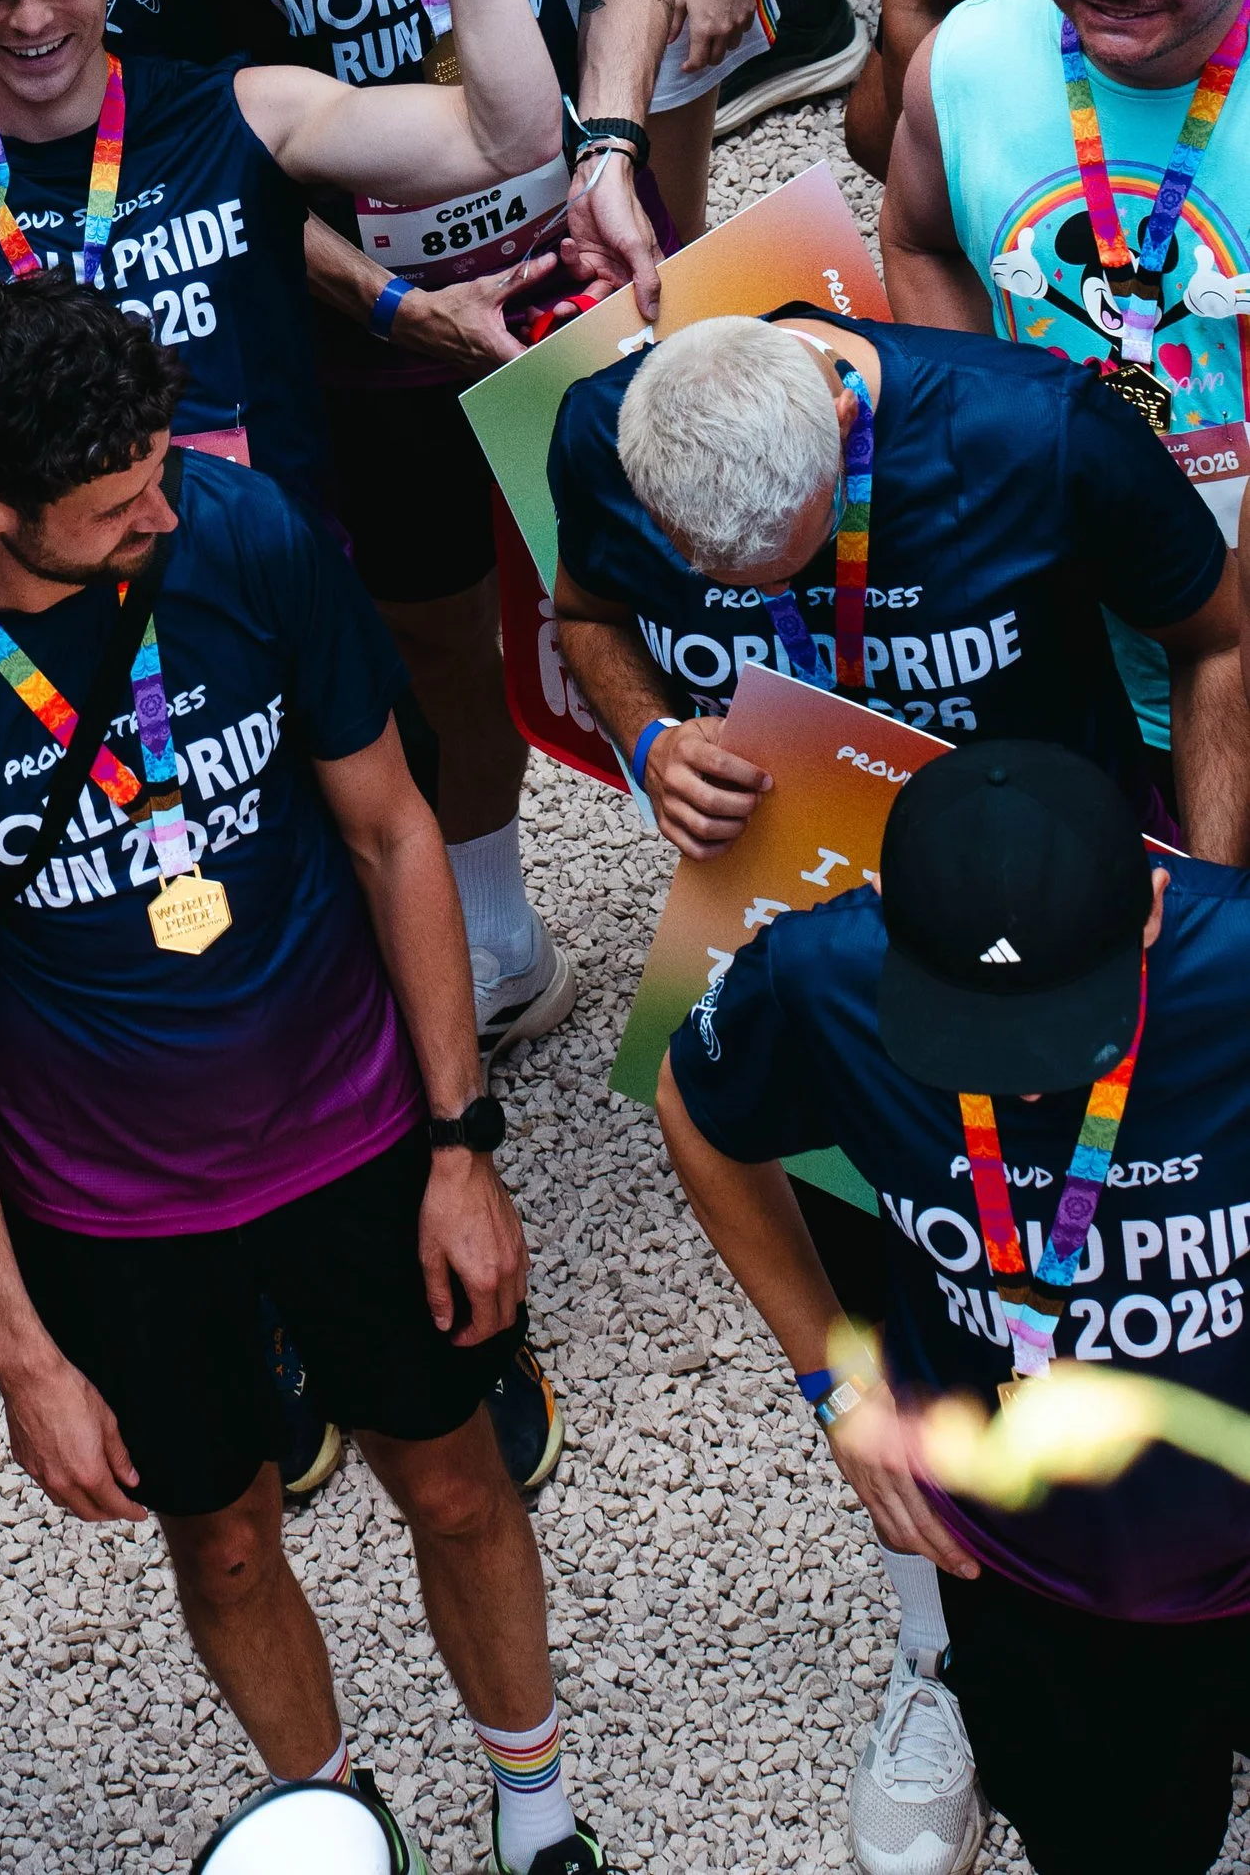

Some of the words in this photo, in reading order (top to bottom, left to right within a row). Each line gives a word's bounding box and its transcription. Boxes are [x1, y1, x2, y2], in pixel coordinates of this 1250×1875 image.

[331, 12, 424, 87] RUN
[111, 197, 249, 291] PRIDE
[421, 195, 528, 256] 88114
[1167, 443, 1190, 454] LUB
[1183, 450, 1240, 477] 2026
[863, 610, 1023, 692] PRIDE
[836, 745, 912, 785] PROU
[14, 846, 117, 909] UN
[155, 890, 220, 920] WORLD
[165, 905, 215, 931] PRIDE
[1105, 1154, 1203, 1189] RIDES
[1121, 1201, 1250, 1282] PRID
[1069, 1277, 1245, 1361] 2026
